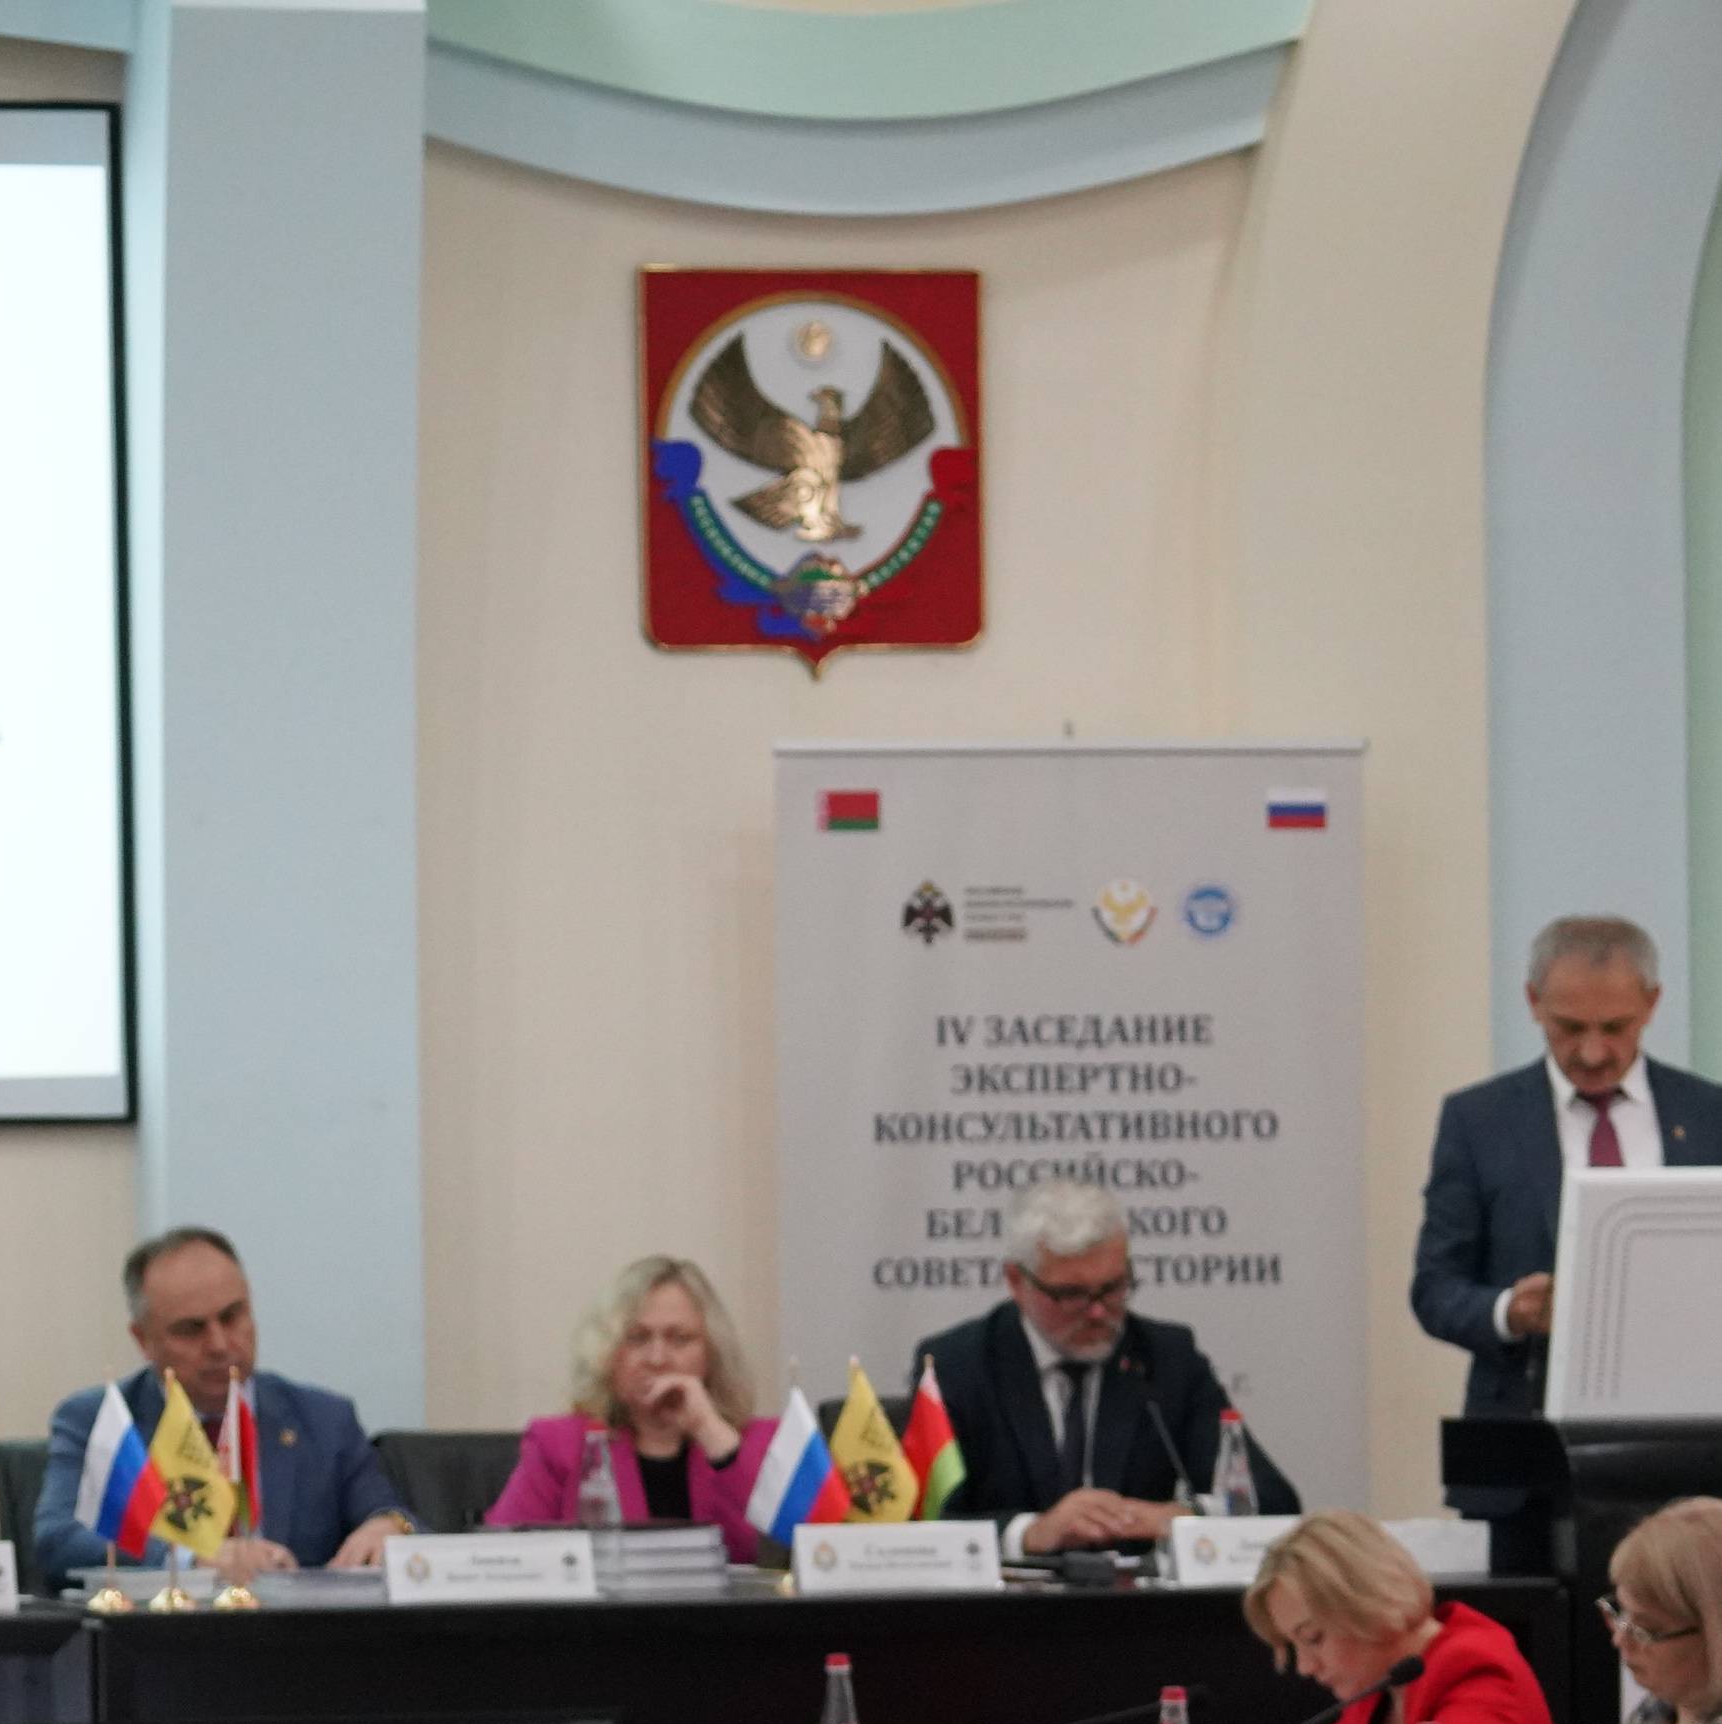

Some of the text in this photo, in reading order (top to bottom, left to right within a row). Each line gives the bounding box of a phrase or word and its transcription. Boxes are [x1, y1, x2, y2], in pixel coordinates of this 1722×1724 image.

[935, 1015, 1213, 1050] IV ЗАСЕДАНИЕ
[951, 1063, 1197, 1095] ЭКСПЕРТНО-
[873, 1109, 1280, 1144] КОНСУЛЬТАТИВНОГО
